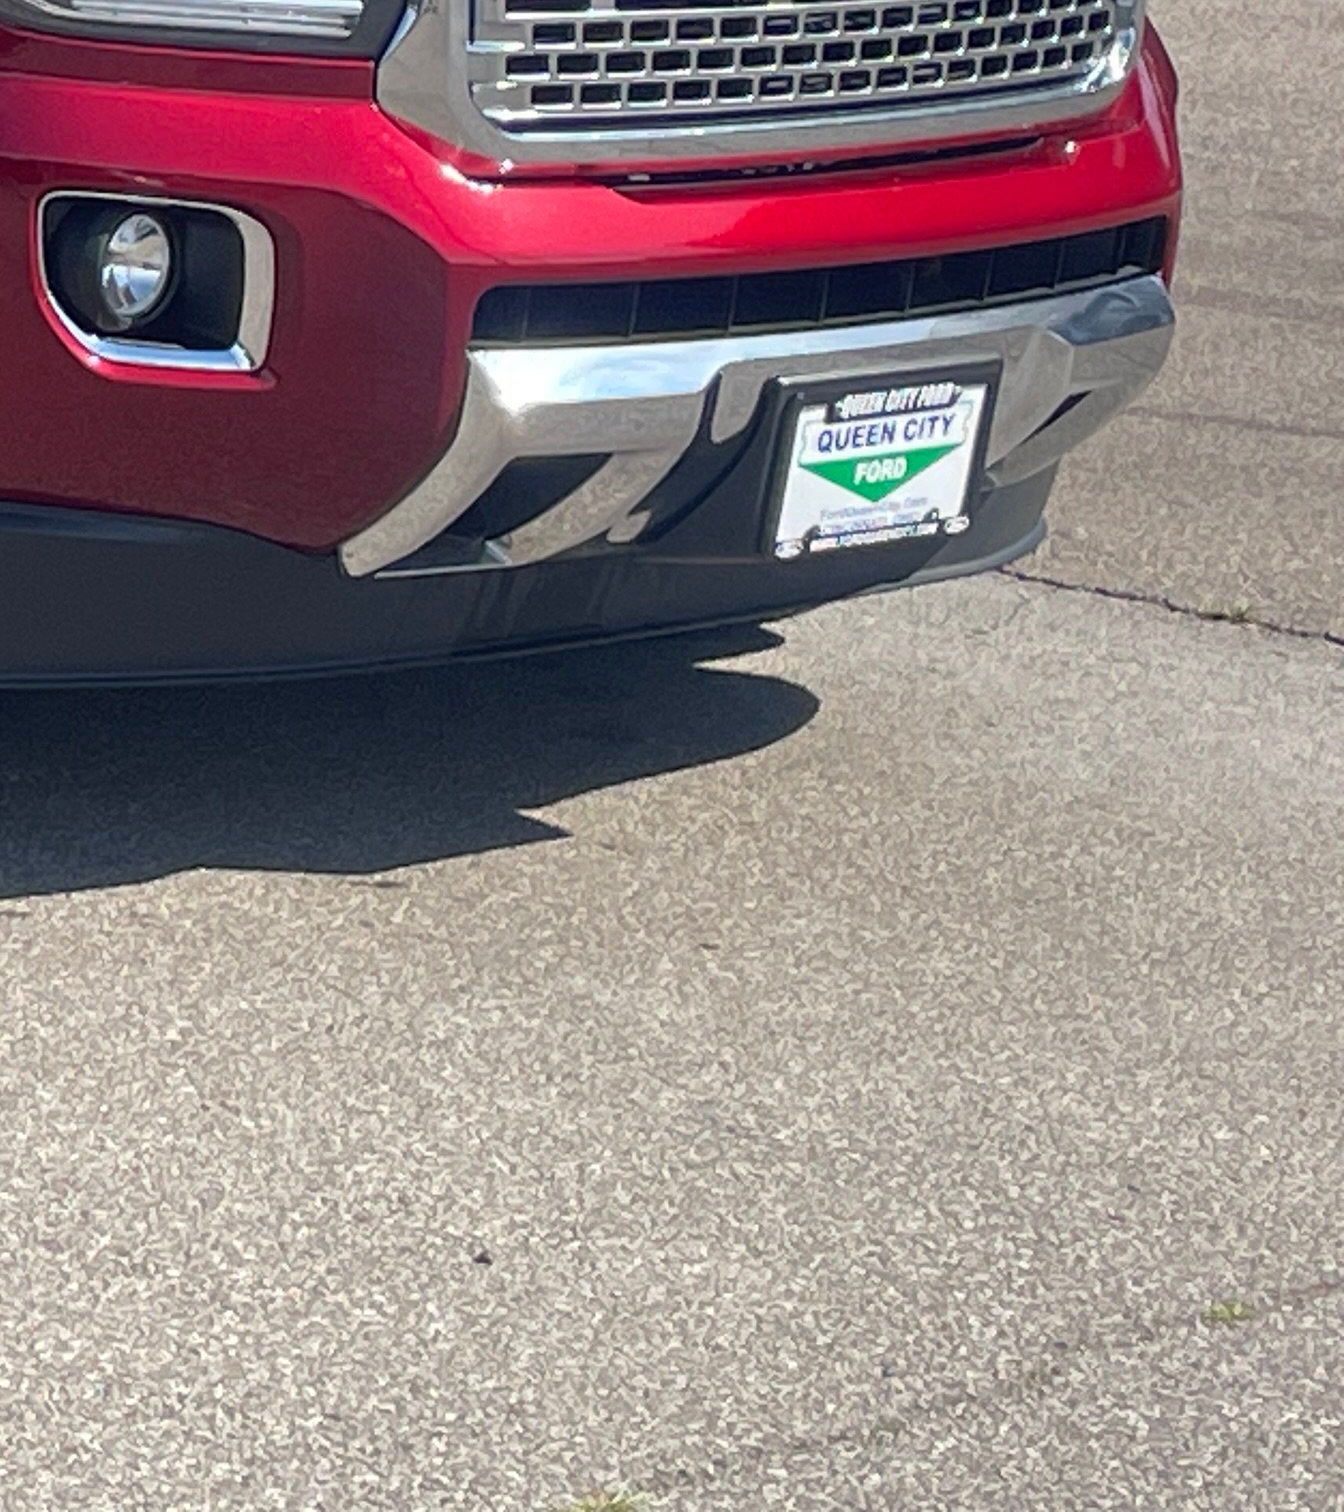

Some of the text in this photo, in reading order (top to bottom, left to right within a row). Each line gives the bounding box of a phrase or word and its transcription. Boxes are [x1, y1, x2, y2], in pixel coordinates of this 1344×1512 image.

[817, 413, 957, 453] QUEEN CITY
[853, 456, 908, 486] FORD
